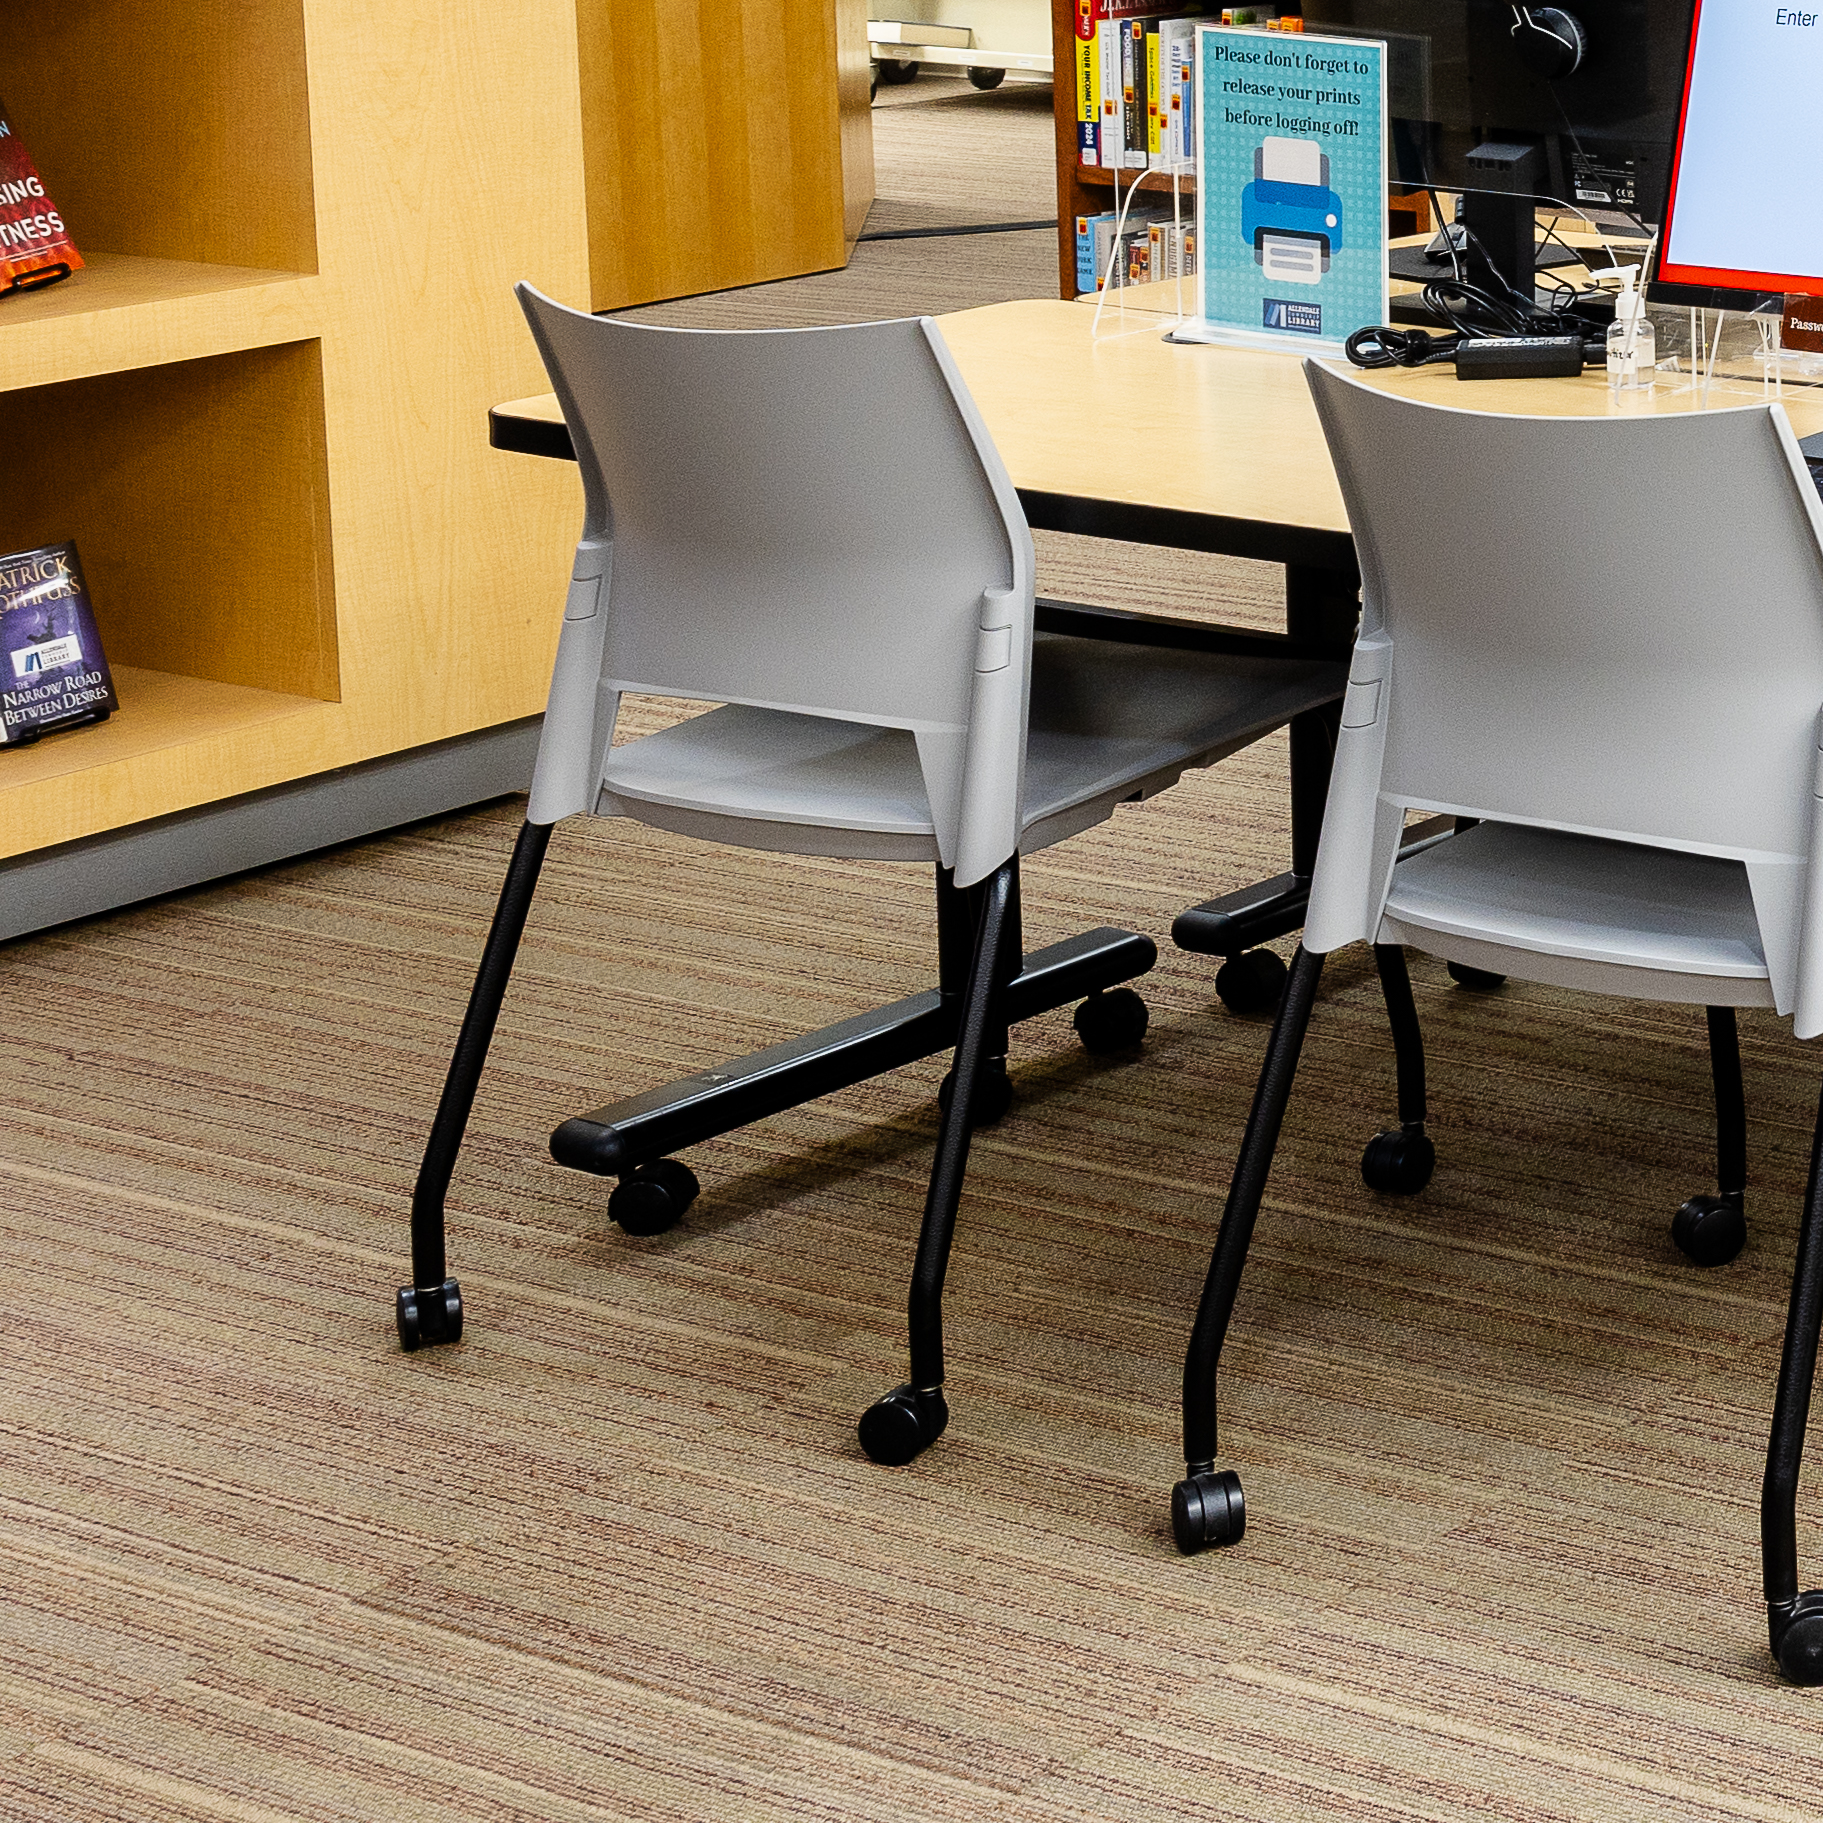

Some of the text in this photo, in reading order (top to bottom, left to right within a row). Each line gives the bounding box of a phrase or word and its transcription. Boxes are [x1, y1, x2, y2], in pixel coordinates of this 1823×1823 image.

[1776, 8, 1818, 28] Enter
[1214, 46, 1369, 75] Please don't forget to
[1222, 79, 1361, 106] release your prints
[1085, 102, 1093, 121] TAX
[1225, 107, 1359, 137] before logging off!
[1085, 123, 1094, 145] 2024
[1287, 316, 1320, 328] LIBRARY
[3, 671, 102, 709] NARROW ROAD
[16, 680, 30, 691] THE
[3, 686, 108, 726] BETWEEN DESIRES
